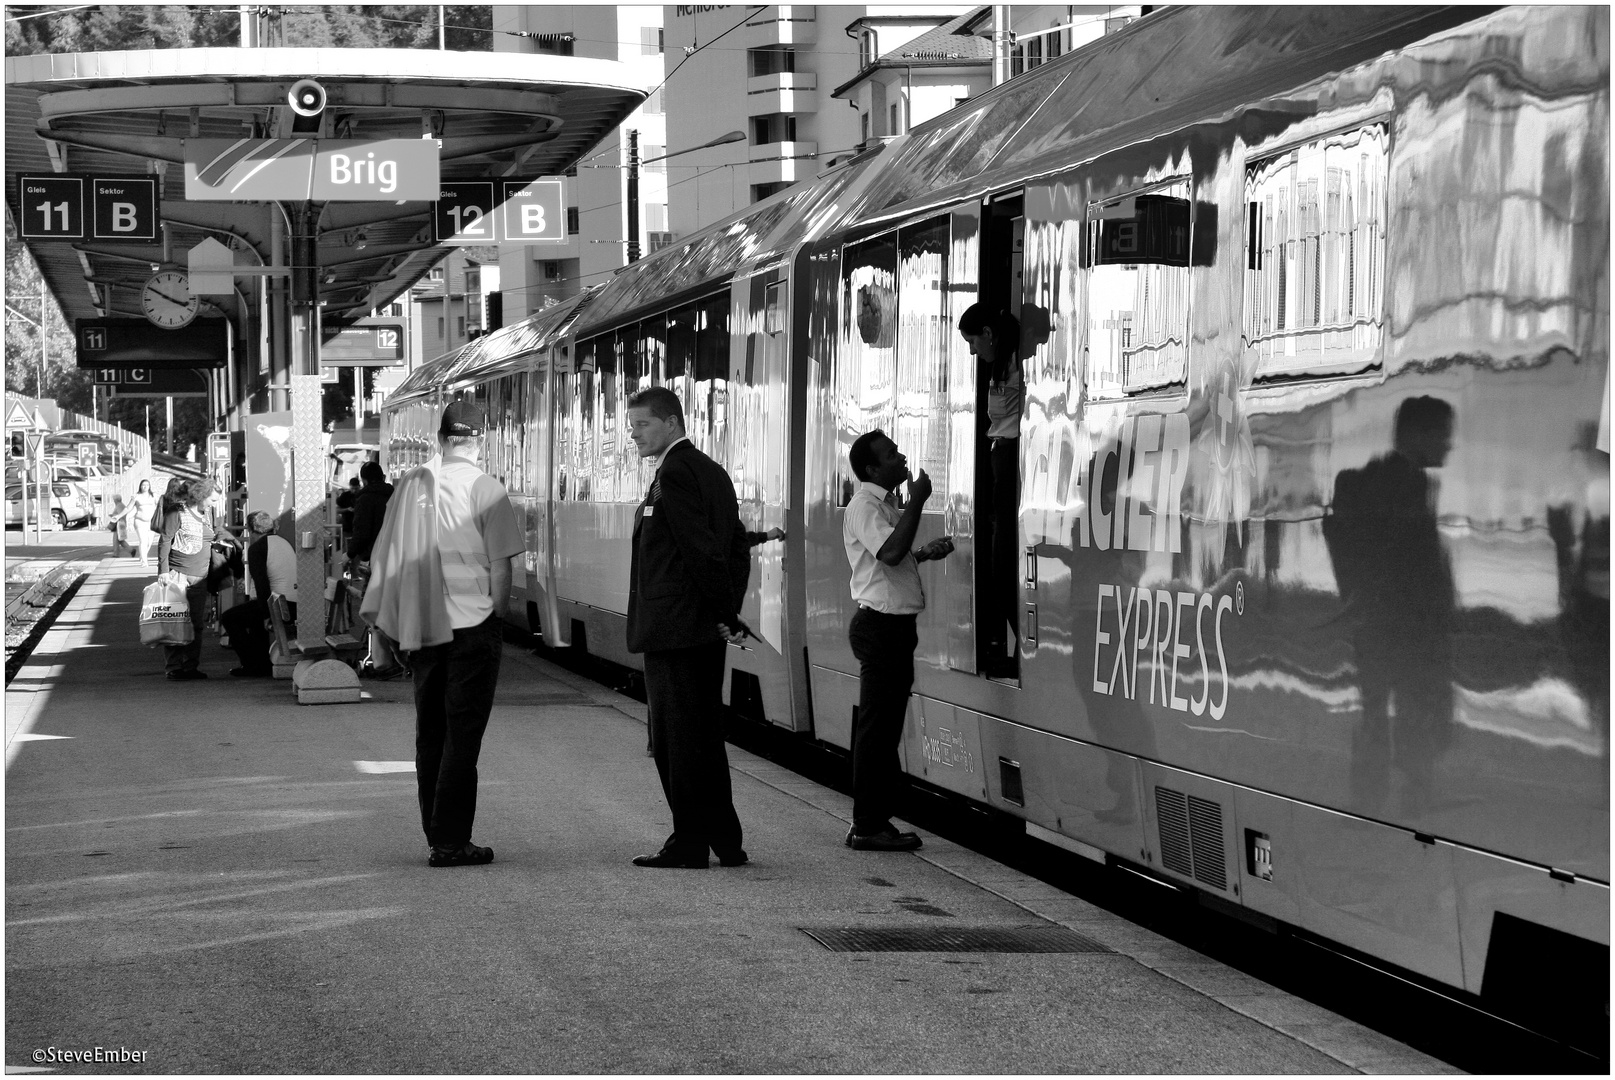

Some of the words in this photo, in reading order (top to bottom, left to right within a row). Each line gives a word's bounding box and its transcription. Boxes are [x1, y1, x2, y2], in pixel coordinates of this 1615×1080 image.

[330, 152, 397, 193] Brig
[99, 187, 124, 195] Sektor
[36, 201, 69, 231] 11
[112, 202, 138, 232] B
[446, 205, 485, 235] 12
[521, 204, 546, 234] B
[87, 333, 103, 348] 11
[380, 331, 399, 347] 12
[100, 368, 116, 382] 11
[131, 368, 145, 381] C
[1023, 413, 1190, 553] GLACIER
[151, 610, 189, 618] Discount
